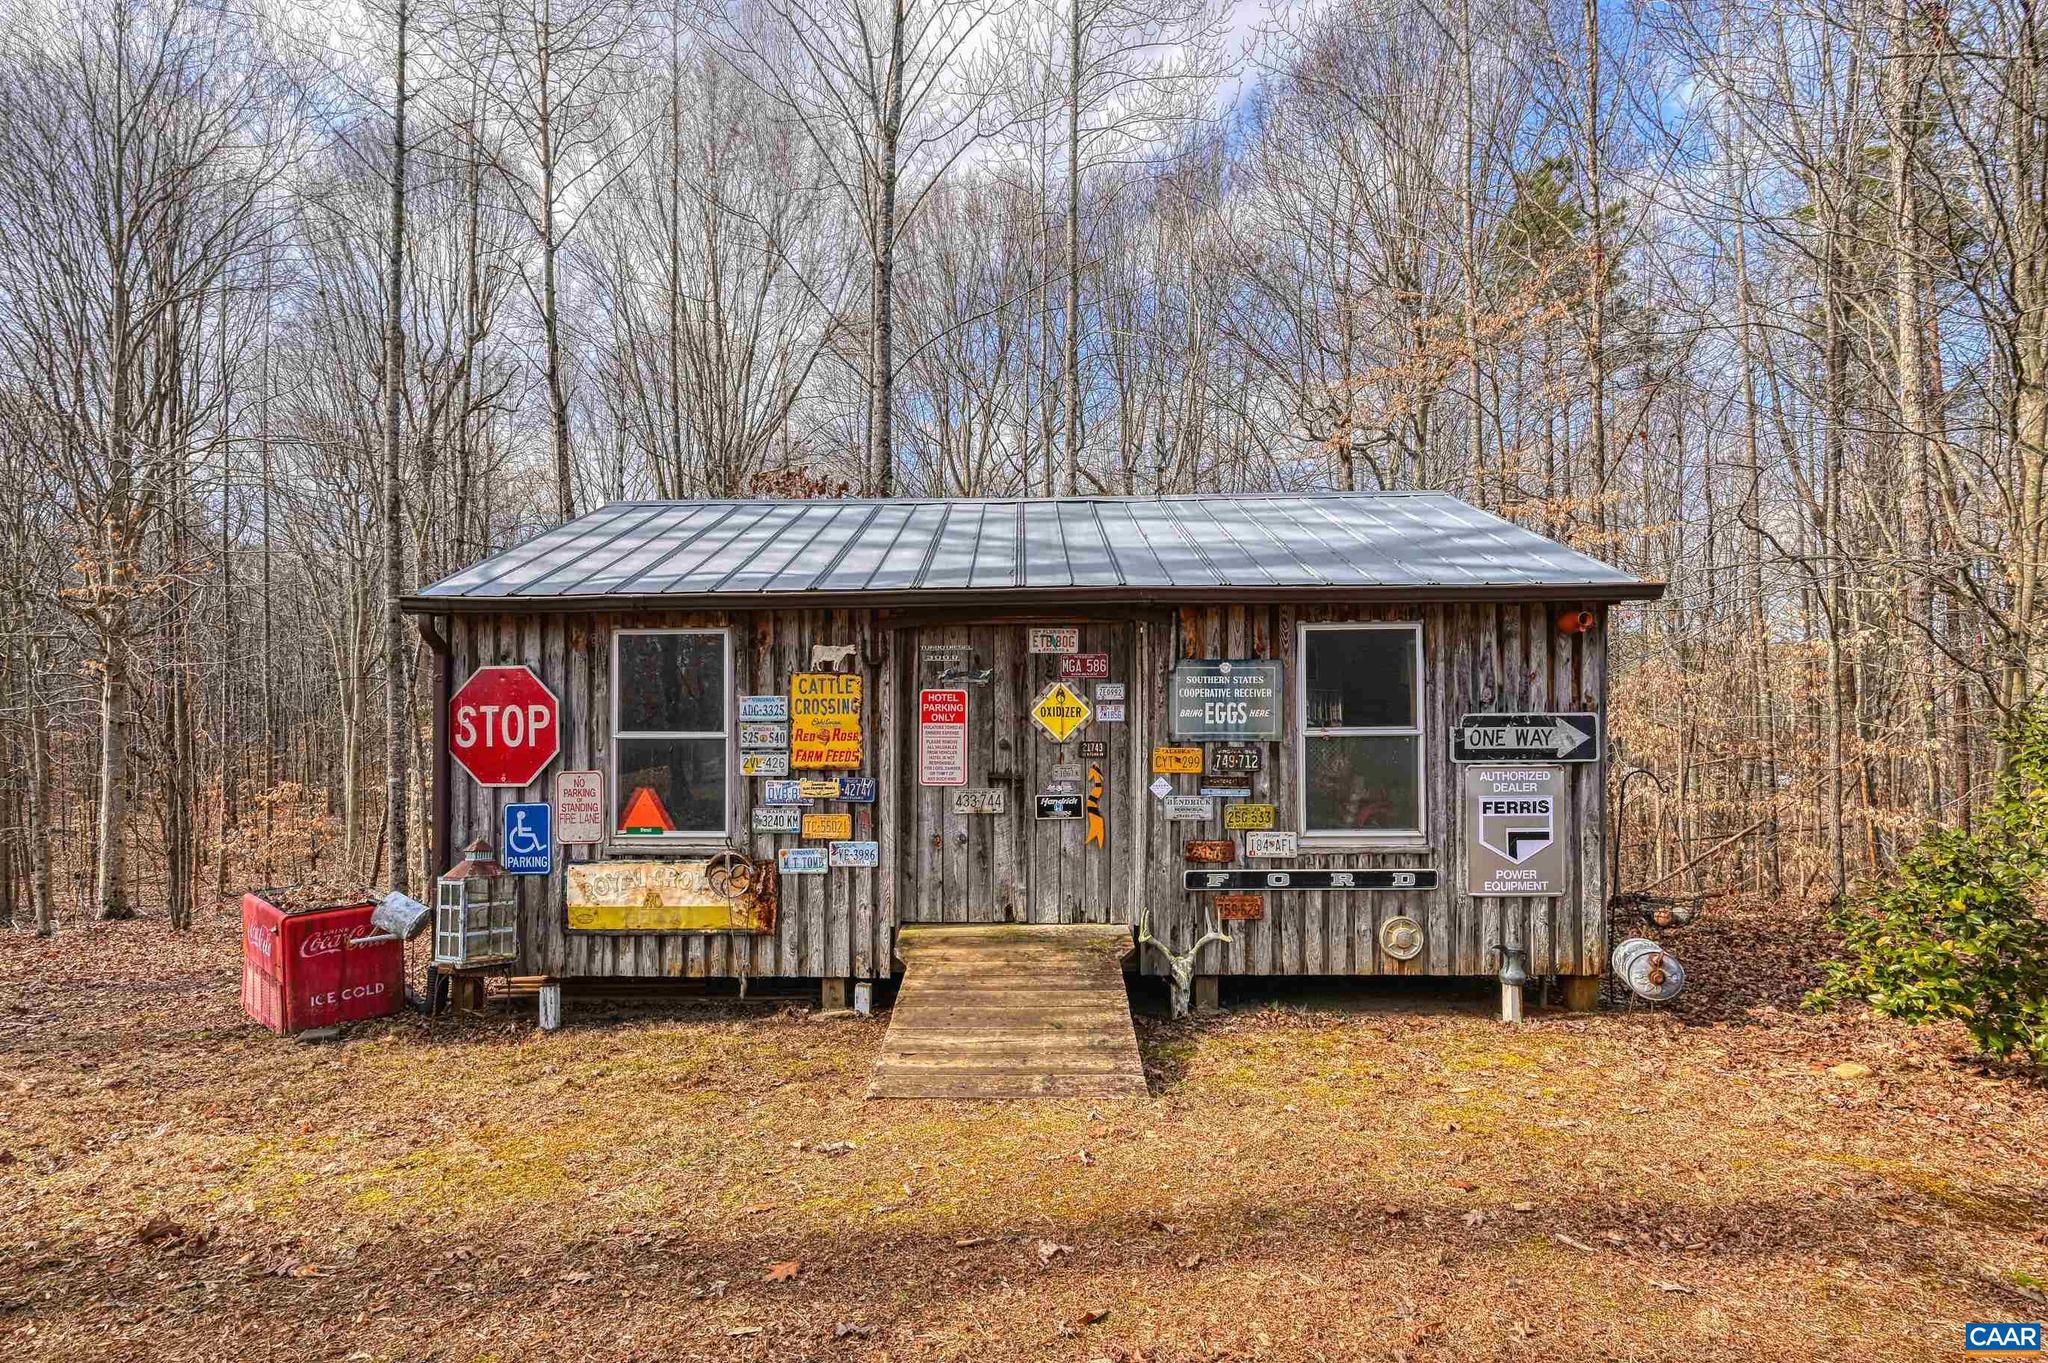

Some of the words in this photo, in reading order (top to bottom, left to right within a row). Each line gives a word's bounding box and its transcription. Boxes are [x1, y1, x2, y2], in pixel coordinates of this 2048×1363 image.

[1062, 659, 1082, 673] MGA
[1086, 659, 1107, 673] 586
[799, 678, 853, 694] CATTLE
[1186, 676, 1230, 684] SOUTHERN
[1233, 676, 1264, 684] STATES
[928, 694, 959, 702] HOTEL
[1179, 688, 1231, 698] COOPERATIVE
[1234, 688, 1272, 698] RECEIVER
[742, 704, 785, 716] ADG-3325
[795, 698, 859, 715] CROSSING
[923, 704, 964, 712] PARKING
[1040, 706, 1082, 718] OXIDIZER
[931, 714, 956, 722] ONLY
[1180, 709, 1203, 717] BRING
[1204, 702, 1248, 724] EGGS
[1249, 709, 1271, 717] HERE
[455, 704, 550, 748] STOP
[742, 731, 759, 743] 525
[769, 731, 786, 743] 540
[795, 729, 815, 742] RED
[832, 728, 858, 742] ROSE
[1470, 729, 1506, 747] ONE
[1515, 729, 1553, 747] WAY
[795, 749, 823, 762] FARM
[825, 749, 859, 762] FEEDS
[1480, 771, 1550, 781] AUTHORIZED
[573, 778, 586, 788] NO
[1493, 783, 1538, 792] DEALER
[563, 788, 596, 798] PARKING
[561, 803, 599, 812] STANDING
[1482, 801, 1550, 814] FERRIS
[560, 813, 577, 825] FIRE
[579, 813, 600, 825] LANE
[762, 815, 785, 827] 3240
[787, 815, 799, 827] KM
[508, 856, 548, 867] PARKING
[1206, 873, 1416, 887] FORD
[1496, 870, 1537, 879] POWER
[1484, 881, 1549, 891] EQUIPMENT
[311, 993, 336, 1006] ICE
[342, 982, 385, 1000] COLD
